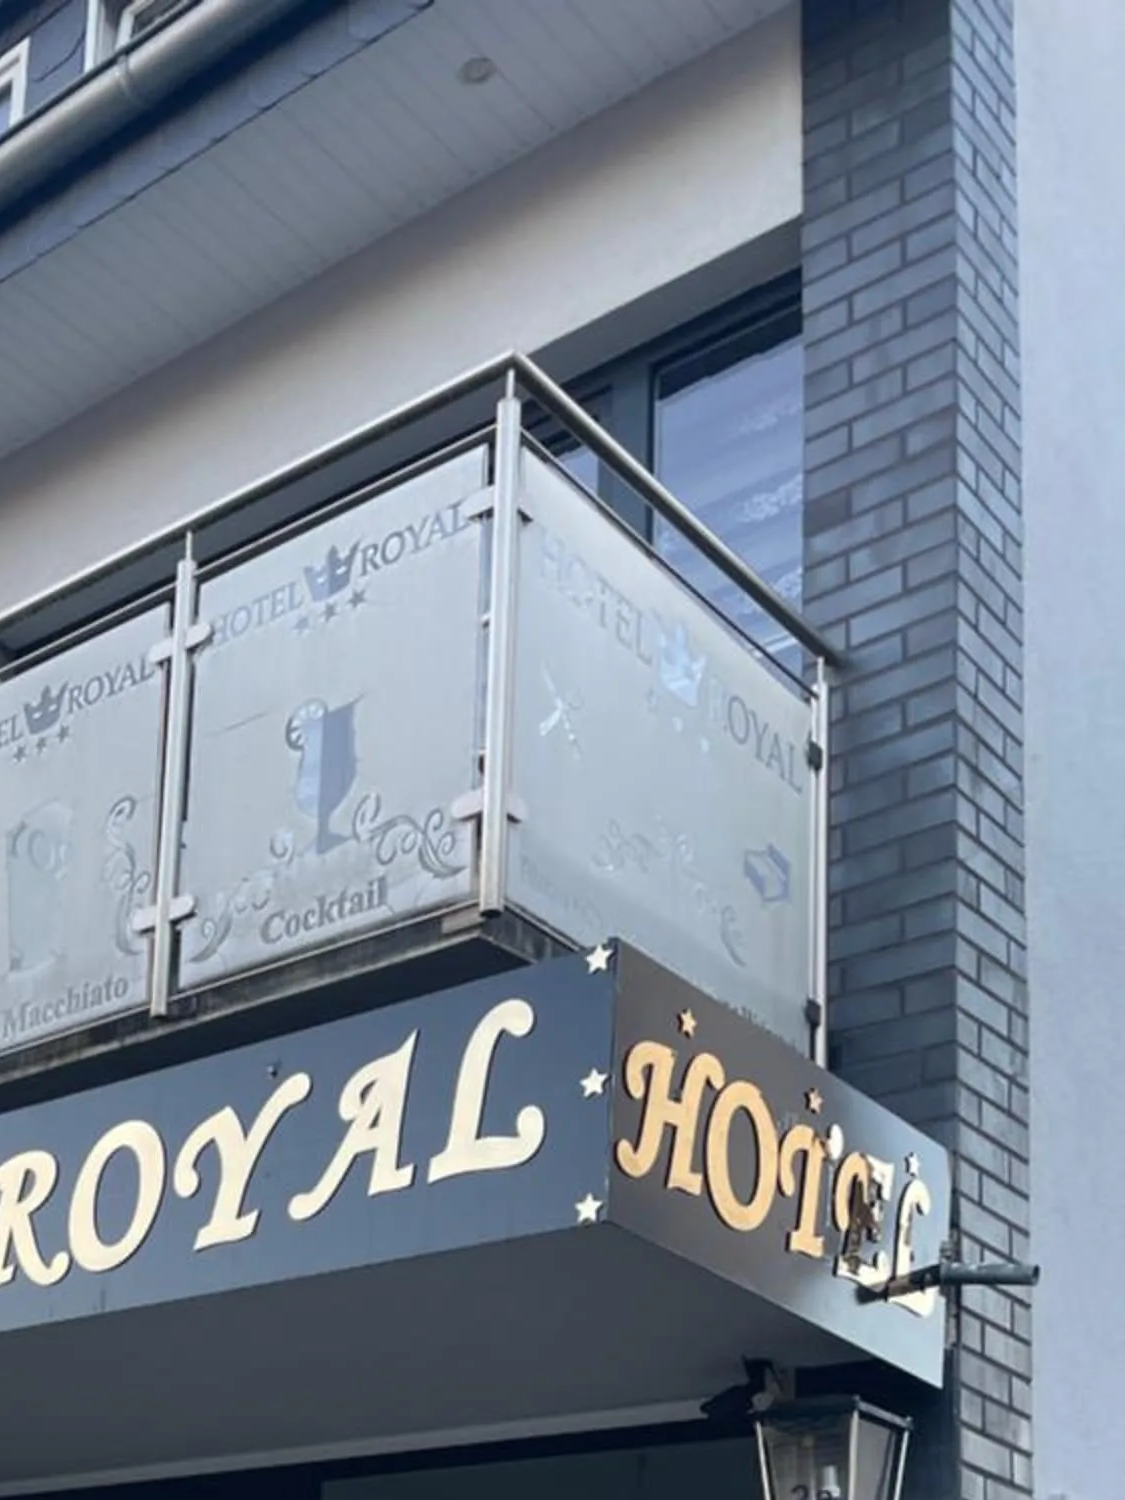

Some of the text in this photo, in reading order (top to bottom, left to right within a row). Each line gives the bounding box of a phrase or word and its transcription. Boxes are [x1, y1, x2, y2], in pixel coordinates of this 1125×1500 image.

[210, 499, 473, 647] HOTEL ROYAL
[65, 656, 159, 714] ROYAL
[260, 875, 389, 947] Cocktail
[616, 1039, 935, 1319] HOTEL
